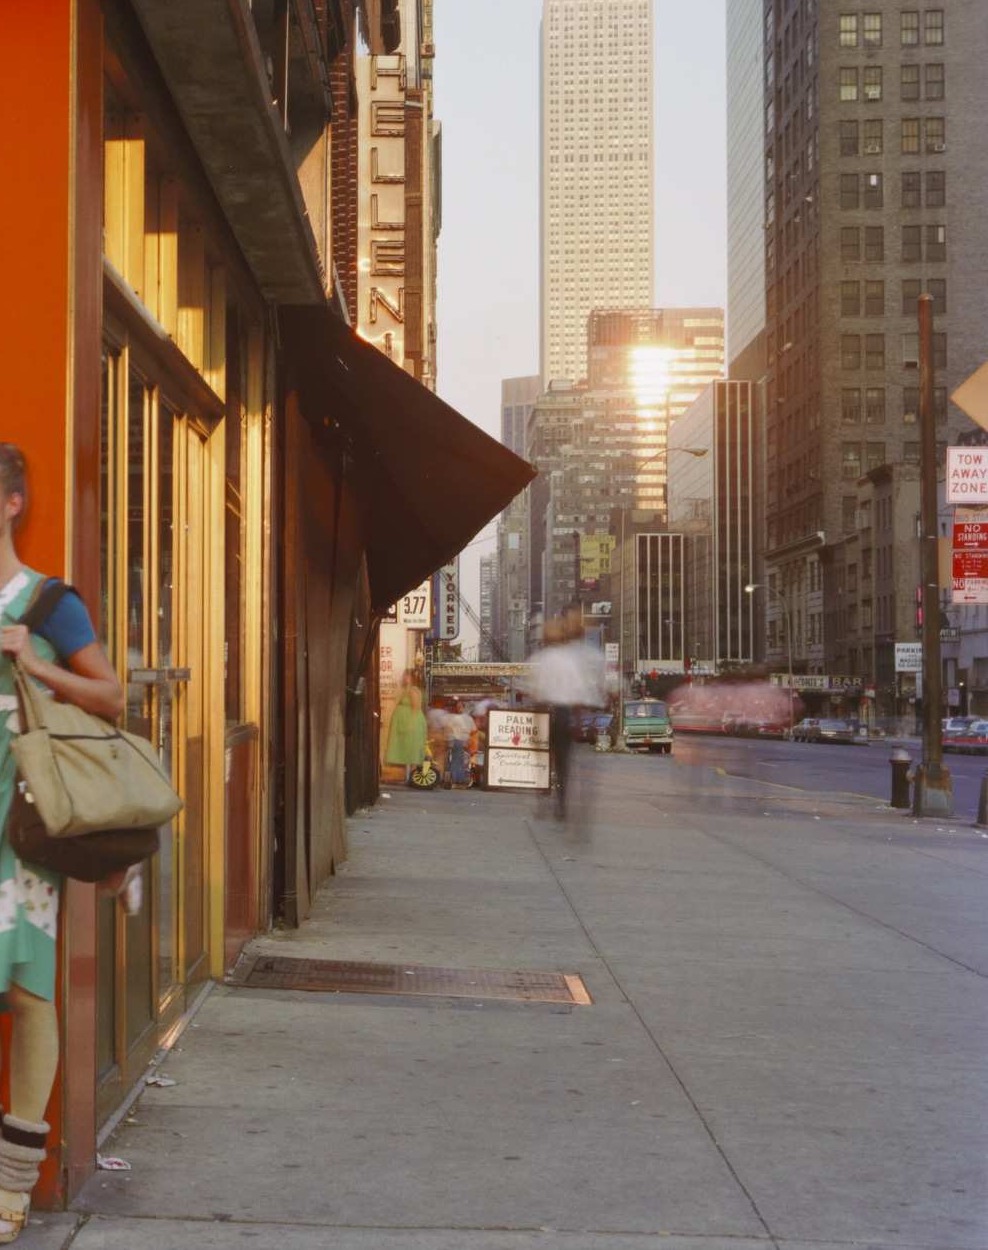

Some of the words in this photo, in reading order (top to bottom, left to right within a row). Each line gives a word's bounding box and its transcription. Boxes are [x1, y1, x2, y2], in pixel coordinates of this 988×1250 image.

[957, 454, 983, 465] TOW
[951, 468, 988, 479] AWAY
[951, 482, 988, 493] ZONE
[963, 524, 981, 533] NO
[957, 532, 988, 542] STANDING
[403, 596, 427, 615] 3.77
[445, 573, 456, 636] YORKER
[832, 677, 862, 687] BAR
[506, 715, 533, 725] PALM
[498, 725, 538, 736] READING
